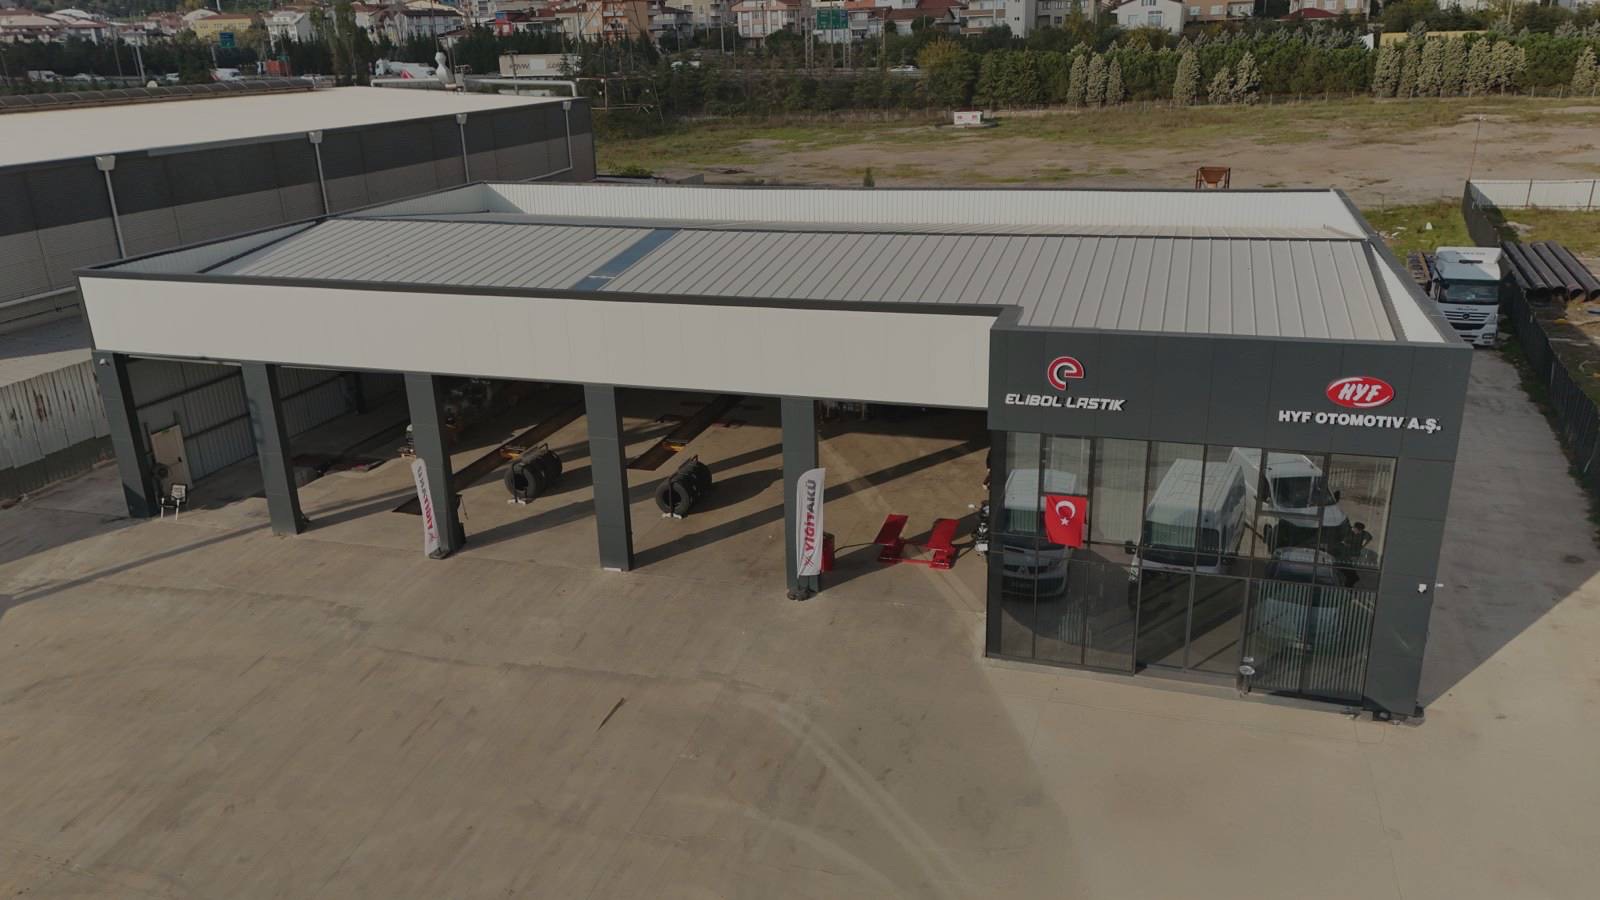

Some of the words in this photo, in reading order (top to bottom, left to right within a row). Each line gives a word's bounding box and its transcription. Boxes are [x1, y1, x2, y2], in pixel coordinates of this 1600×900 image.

[1005, 393, 1063, 407] ELIBOL
[1066, 396, 1126, 411] LASTIK
[1338, 383, 1383, 402] HYF
[1278, 410, 1313, 424] HYF
[1315, 412, 1405, 429] OTOMOTIV
[1407, 417, 1442, 434] A.Ş.
